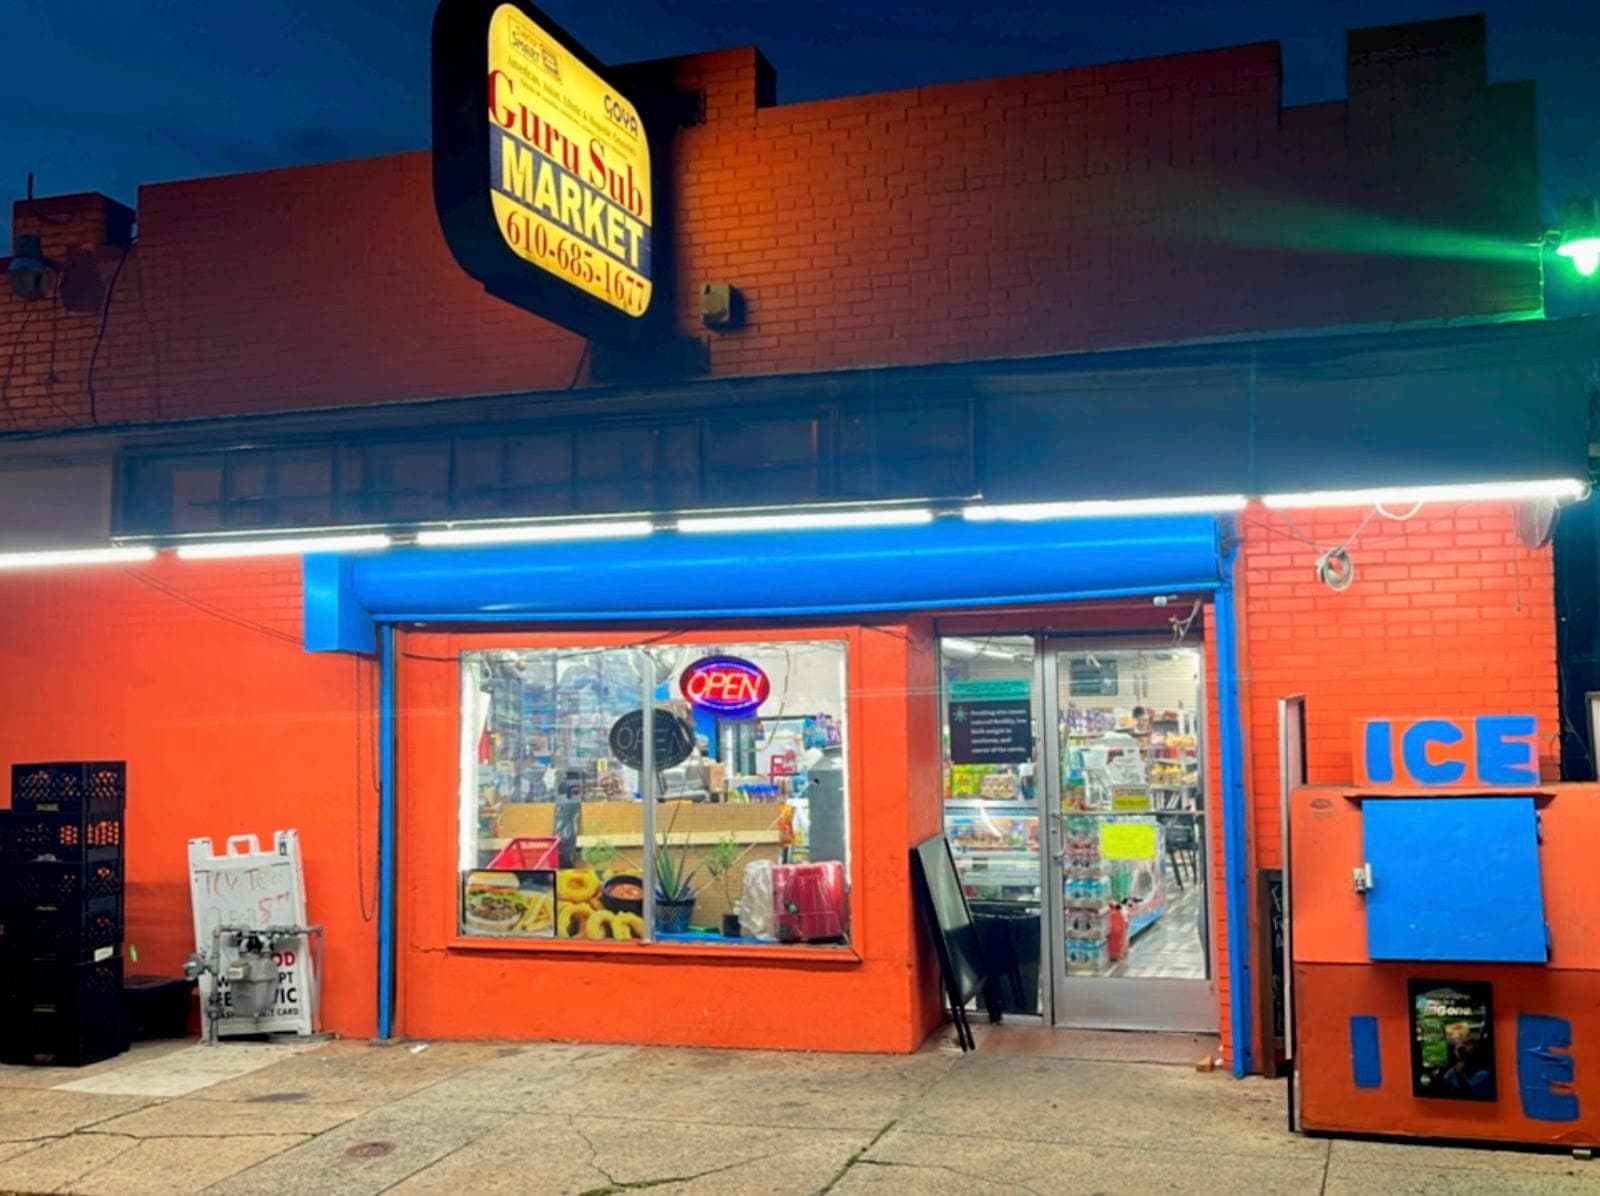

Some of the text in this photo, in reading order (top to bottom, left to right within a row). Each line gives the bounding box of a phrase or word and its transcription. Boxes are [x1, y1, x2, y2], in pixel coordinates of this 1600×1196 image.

[488, 69, 579, 176] Guru
[589, 138, 643, 217] Sub
[603, 94, 639, 136] GOYA
[502, 135, 643, 268] MARKET
[507, 211, 644, 311] 610-685-1677
[687, 672, 763, 700] OPEN
[1365, 714, 1539, 787] ICE
[1350, 1013, 1581, 1122] IE
